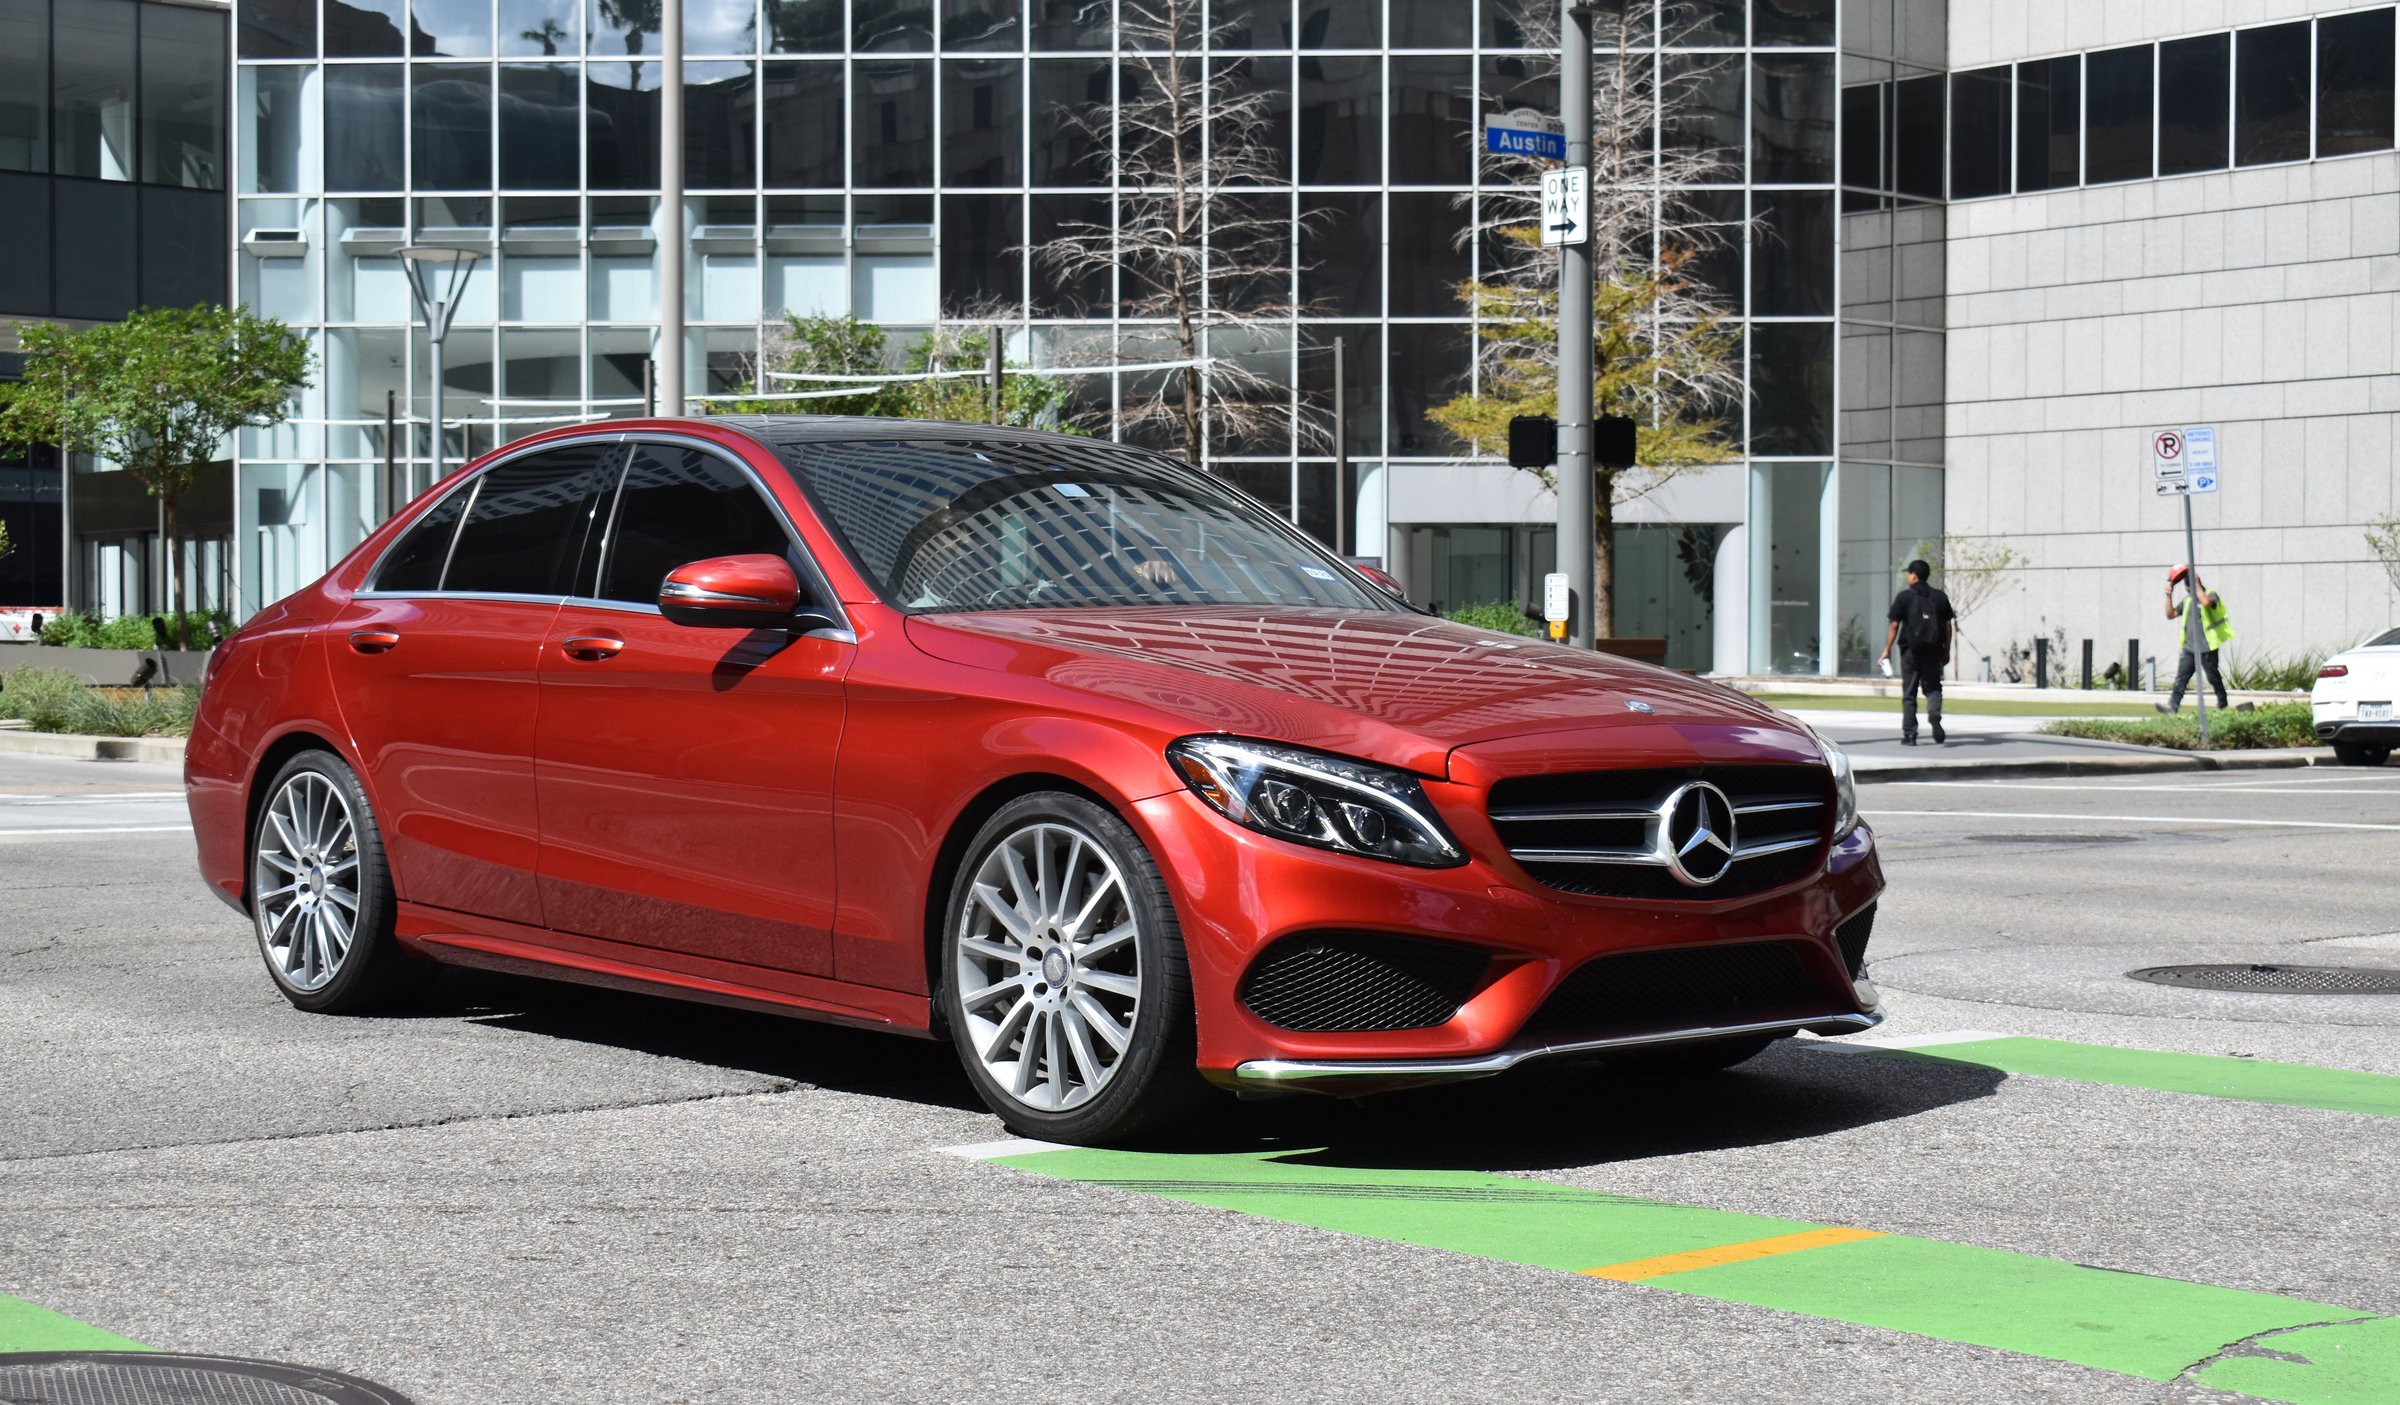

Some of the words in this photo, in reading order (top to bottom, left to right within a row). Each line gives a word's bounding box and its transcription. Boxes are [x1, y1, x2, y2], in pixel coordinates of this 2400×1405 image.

[1513, 110, 1541, 122] HOUSTON
[1516, 120, 1539, 129] CENTER
[1546, 122, 1564, 134] 900
[1499, 131, 1557, 154] Austin
[1548, 176, 1579, 195] ONE
[1547, 196, 1580, 215] WAY
